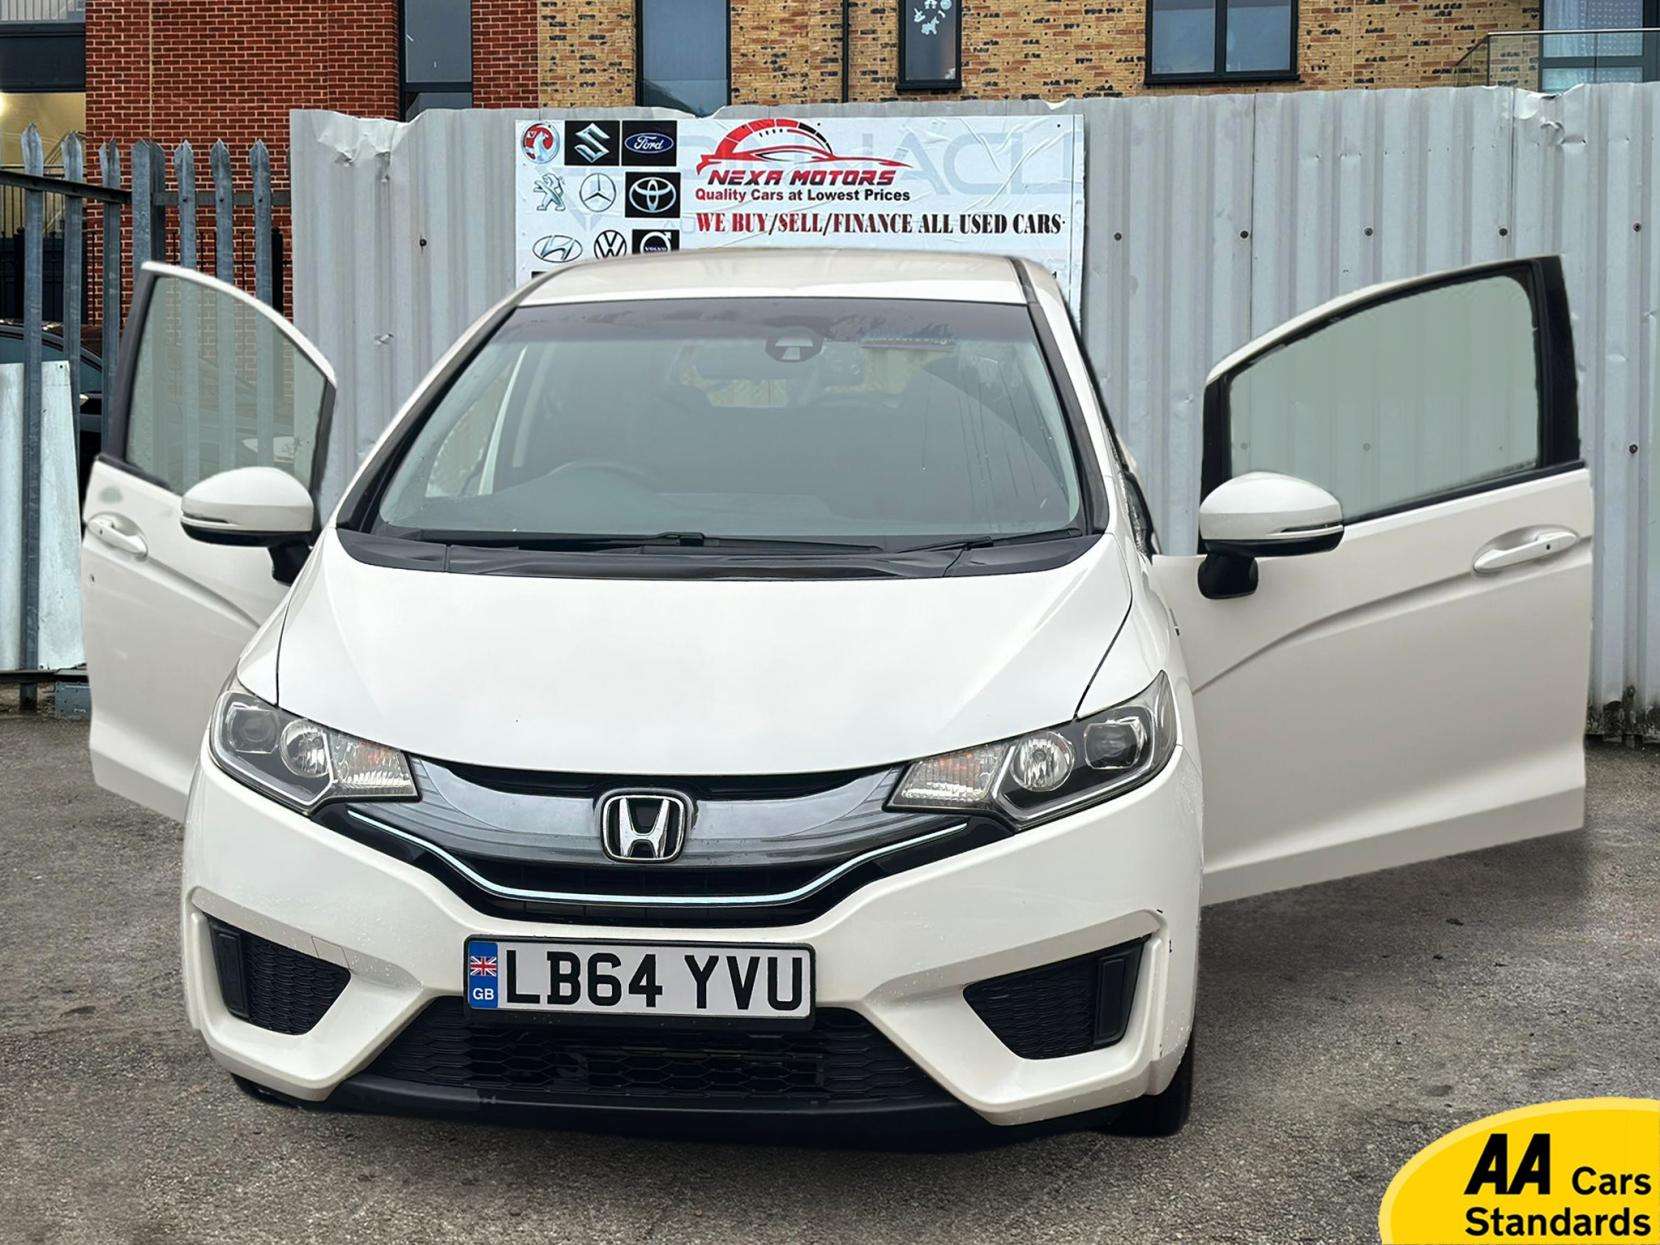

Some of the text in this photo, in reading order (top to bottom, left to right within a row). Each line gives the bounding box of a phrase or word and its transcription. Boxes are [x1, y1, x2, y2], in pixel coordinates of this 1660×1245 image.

[633, 136, 664, 150] Ford
[708, 170, 896, 185] NEXA MOTORS
[695, 188, 910, 203] Quality Cars at Lowest Prices
[696, 213, 726, 232] WE
[732, 212, 912, 236] BUY/SELL/FINANCE
[918, 214, 953, 234] ALL
[959, 214, 1007, 235] USED
[506, 949, 802, 1011] LB64 YVU
[472, 987, 495, 1001] GB
